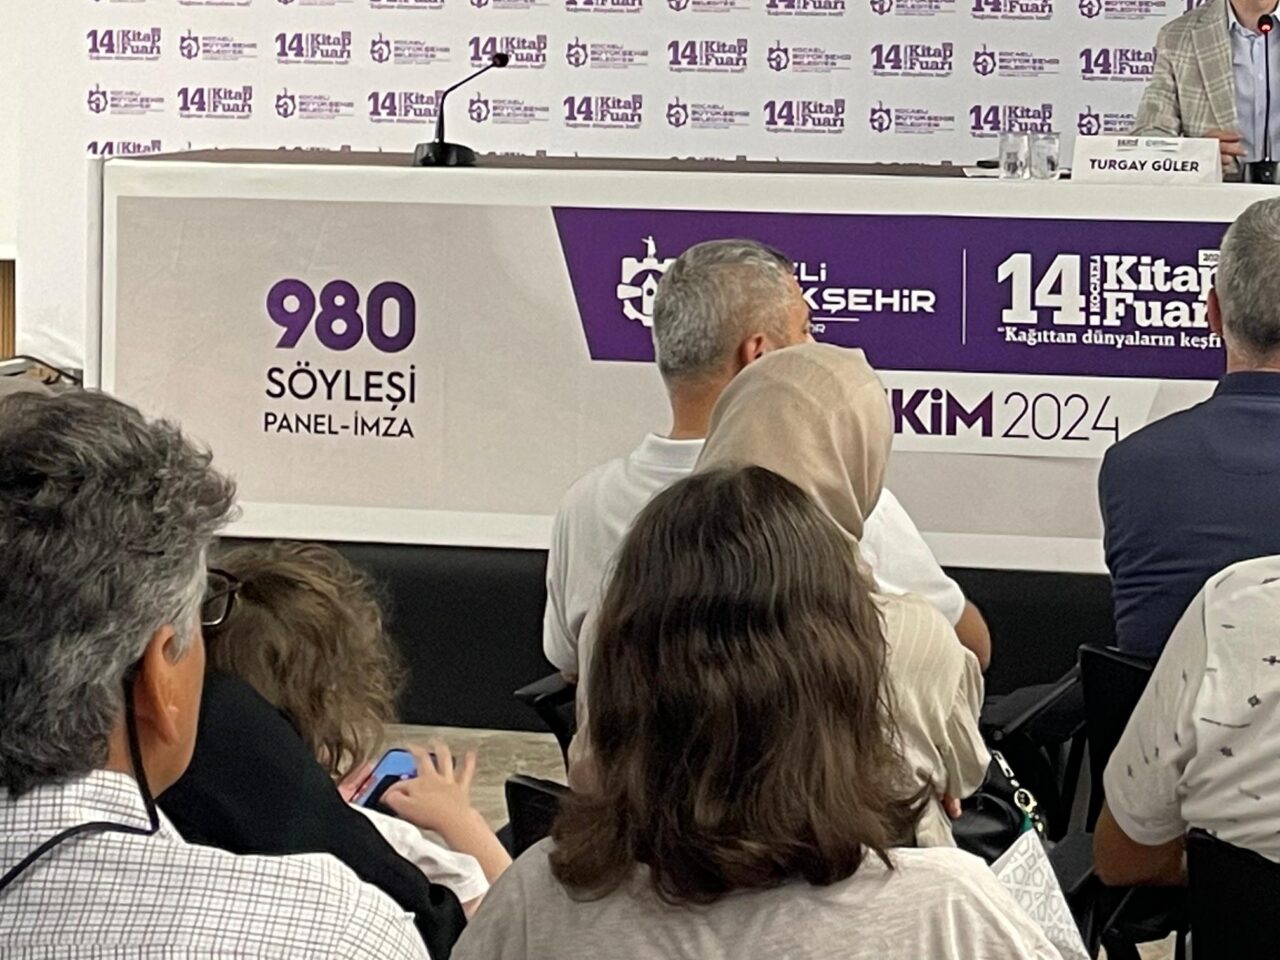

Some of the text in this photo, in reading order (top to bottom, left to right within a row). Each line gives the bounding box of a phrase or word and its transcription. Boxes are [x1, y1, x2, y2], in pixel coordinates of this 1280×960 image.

[275, 33, 304, 57] 14
[668, 41, 697, 65] 14
[764, 101, 794, 126] 14
[801, 101, 846, 118] Kitap
[1089, 158, 1199, 172] TURGAY GÜLER
[997, 252, 1087, 325] 14
[266, 278, 416, 353] 980
[1103, 291, 1209, 328] Fuar
[1082, 329, 1175, 348] dünyaların
[265, 360, 416, 411] SÖYLEŞİ
[264, 410, 415, 438] PANEL-İMZA
[1001, 391, 1119, 442] 2024
